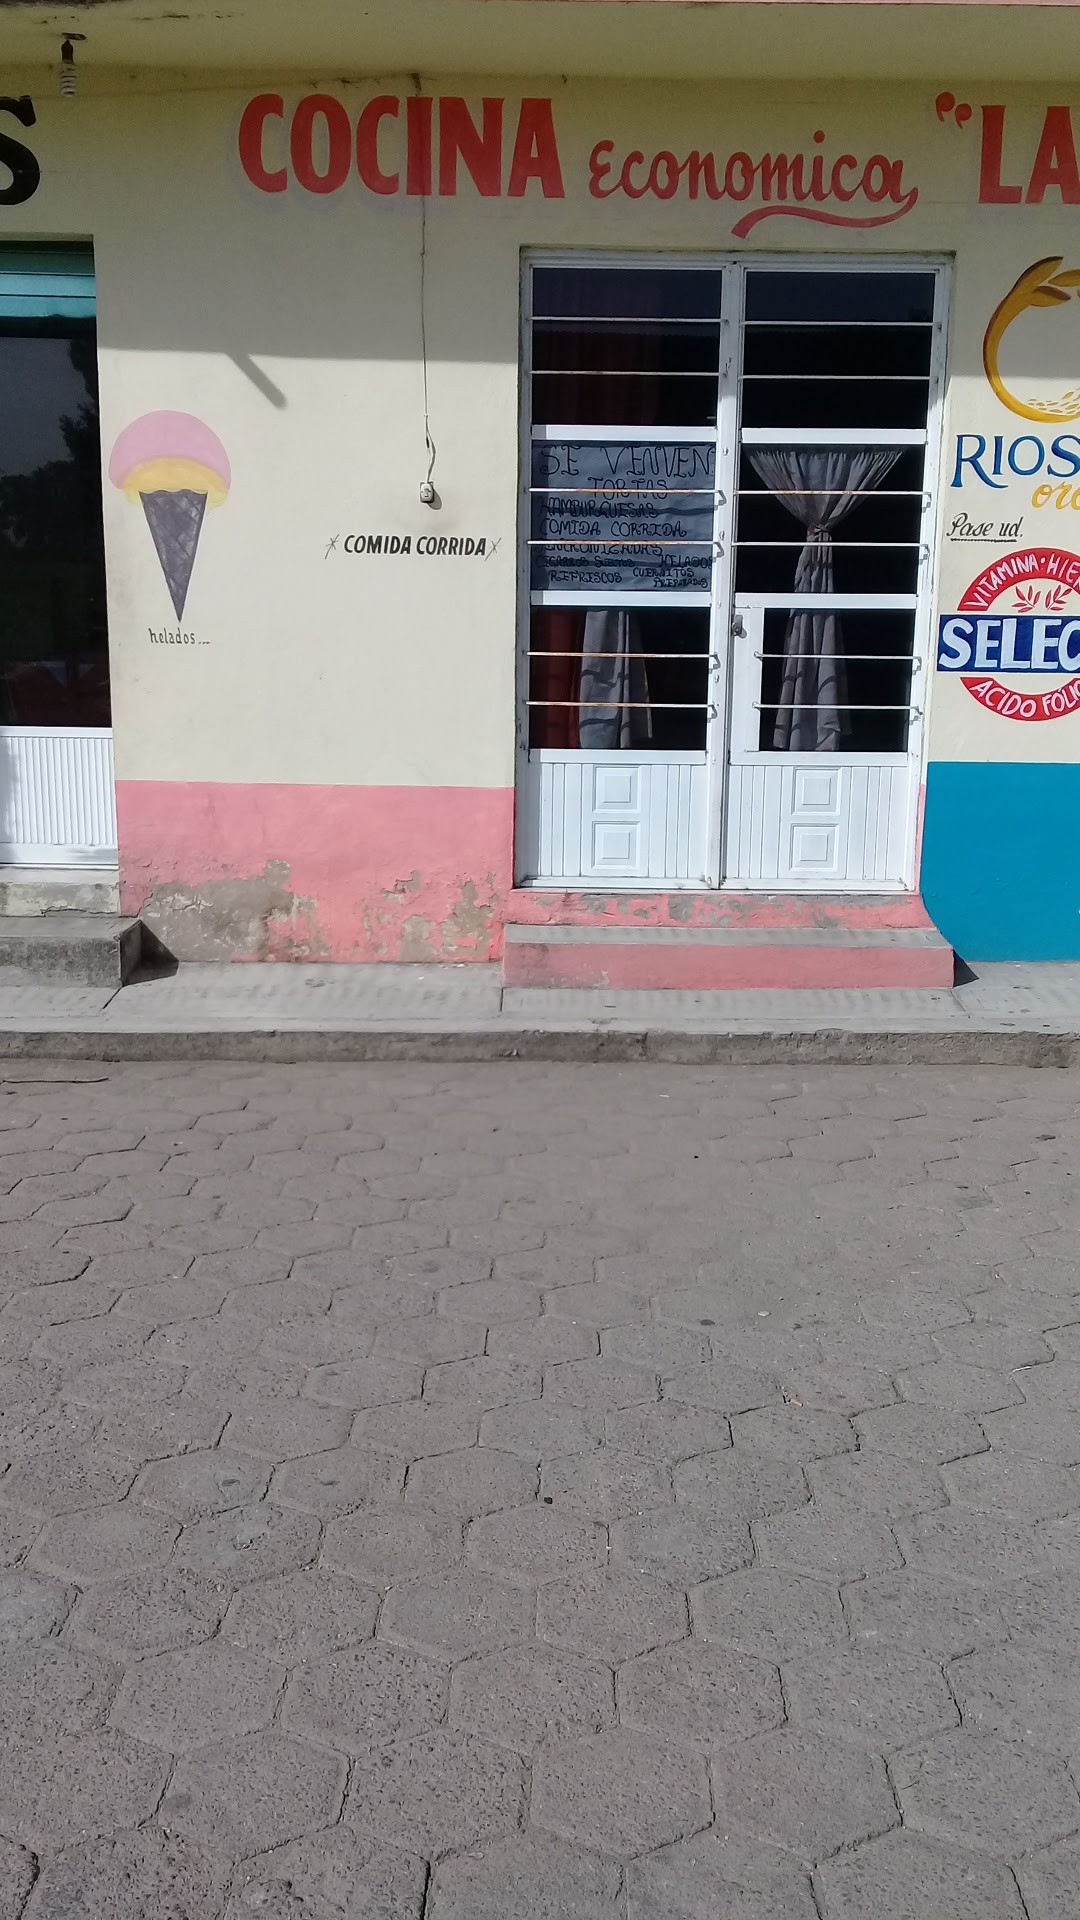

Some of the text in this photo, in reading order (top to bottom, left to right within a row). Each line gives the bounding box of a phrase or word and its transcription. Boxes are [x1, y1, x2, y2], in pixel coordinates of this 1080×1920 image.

[238, 94, 565, 198] COCINA
[589, 139, 918, 239] Economica
[540, 444, 581, 475] SE
[587, 476, 669, 500] TORTAS
[540, 518, 688, 538] COMIDA CORRIDA
[946, 512, 1024, 537] Pase ud.
[343, 535, 487, 556] COMIDA CORRIDA
[964, 553, 1039, 607] VITAMINA
